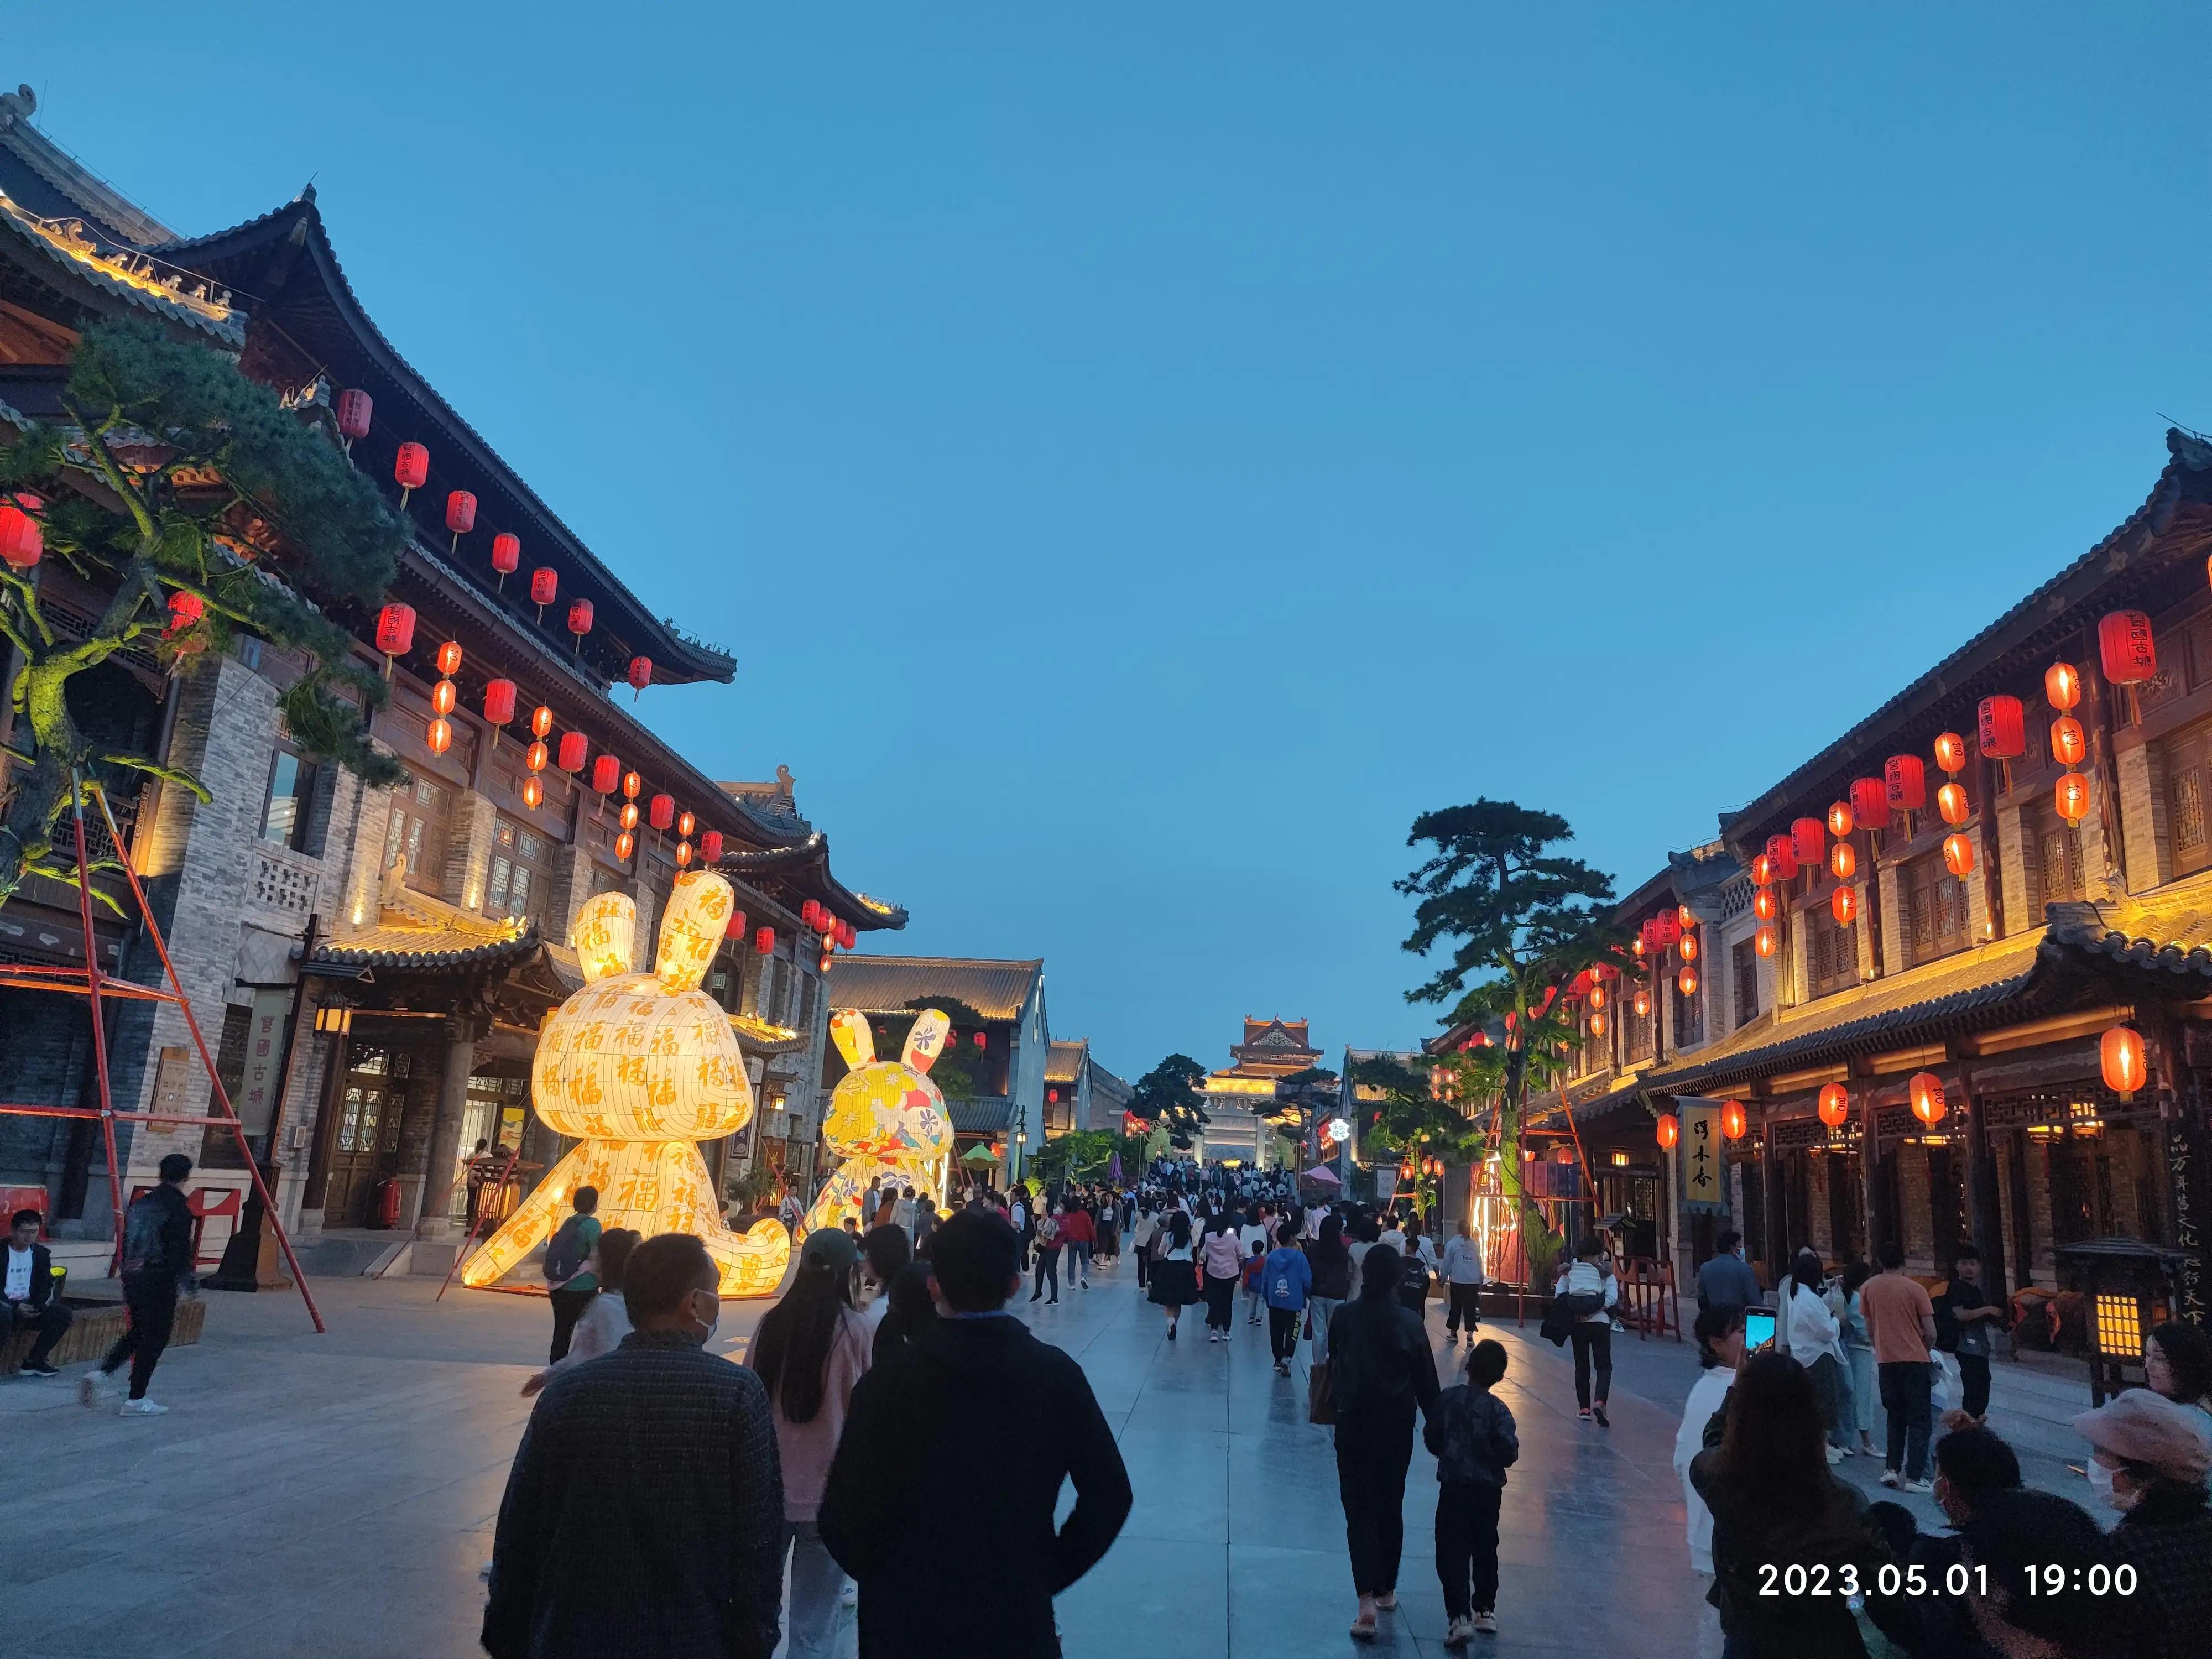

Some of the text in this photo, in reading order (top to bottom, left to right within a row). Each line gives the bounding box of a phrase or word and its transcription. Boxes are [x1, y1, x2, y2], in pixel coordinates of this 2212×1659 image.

[699, 885, 727, 920] 福
[581, 919, 610, 951] 福
[546, 1024, 563, 1052] 福
[573, 1019, 606, 1052] 福
[614, 1019, 645, 1048] 福
[651, 1027, 679, 1056] 福
[692, 1016, 717, 1047] 福
[568, 1062, 602, 1106] 福
[617, 1054, 647, 1087] 福
[696, 1056, 724, 1087] 福
[648, 1068, 677, 1107] 福
[588, 1160, 611, 1194] 福
[669, 1148, 698, 1177] 福
[618, 1168, 659, 1212] 福
[672, 1177, 698, 1212] 福
